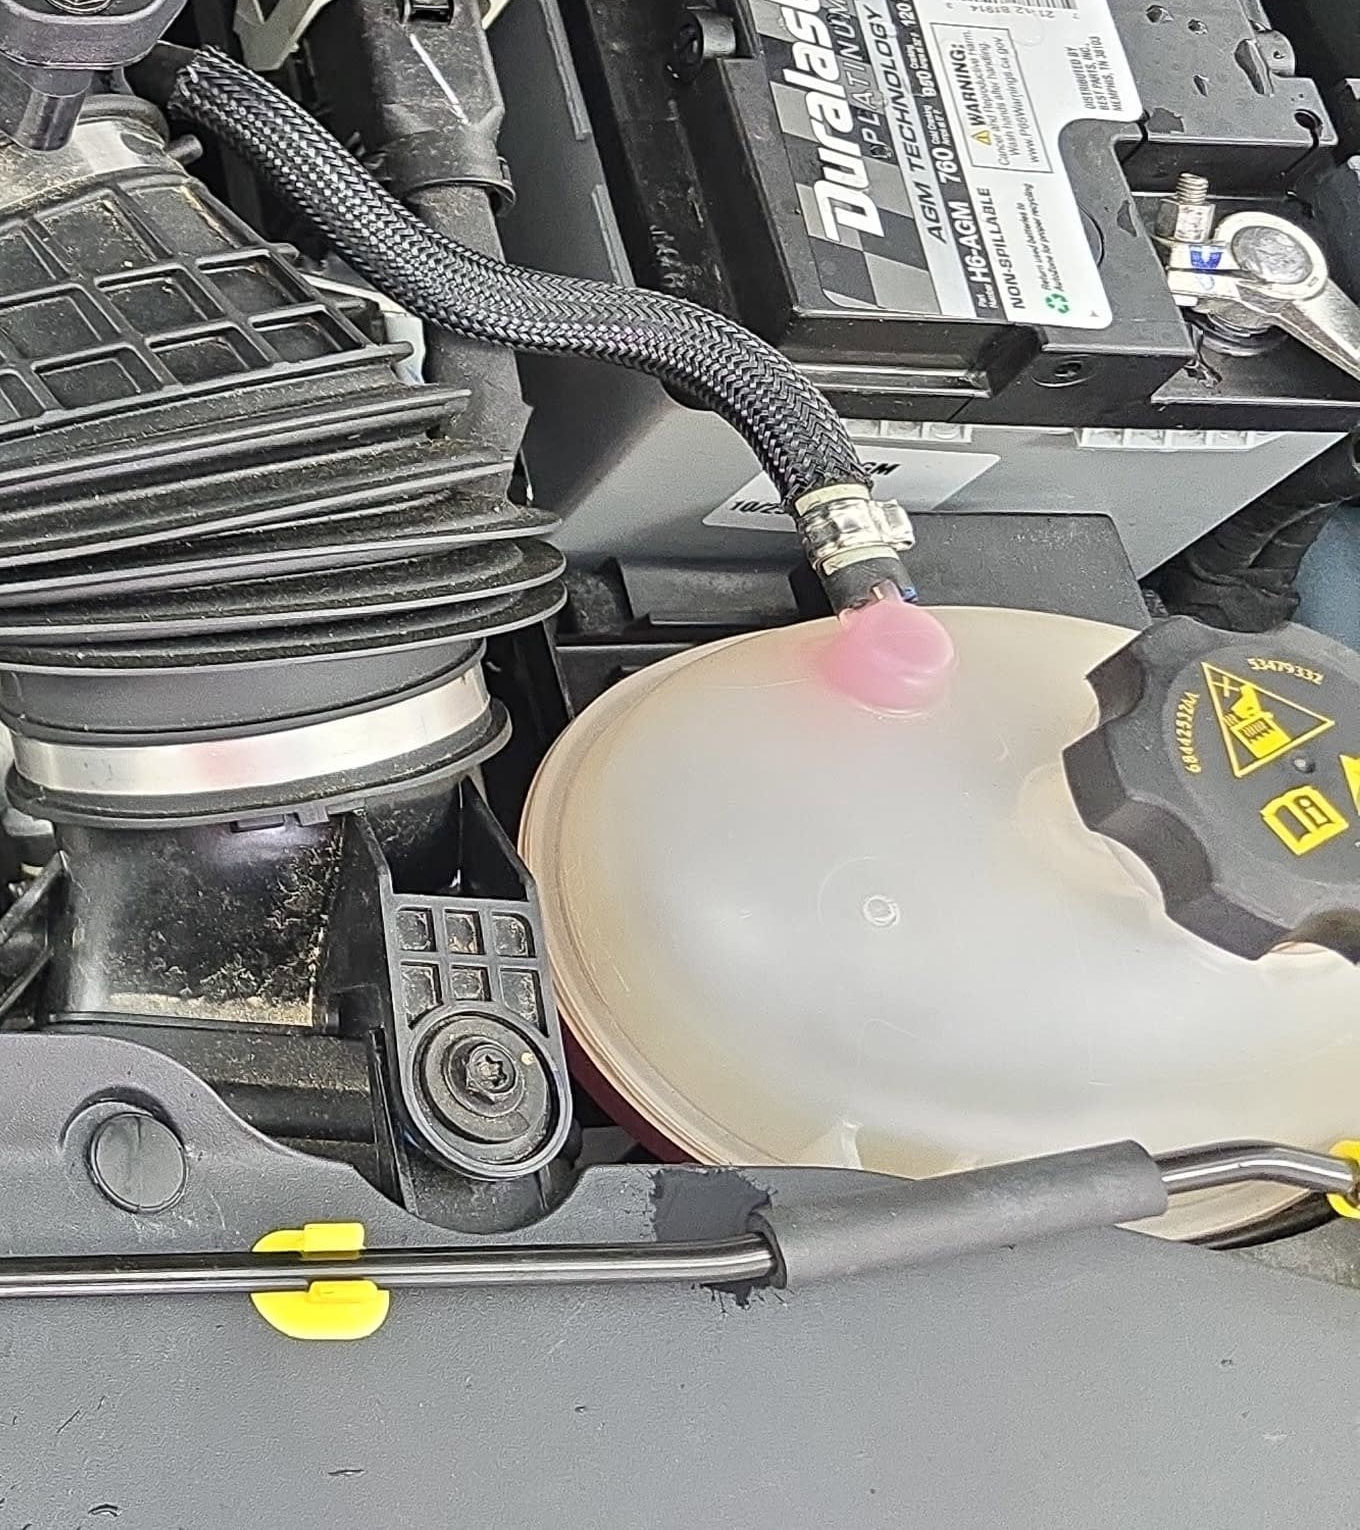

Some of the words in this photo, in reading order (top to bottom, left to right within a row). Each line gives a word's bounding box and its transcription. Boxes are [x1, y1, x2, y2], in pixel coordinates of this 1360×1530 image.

[896, 2, 916, 26] 120
[865, 6, 924, 170] TECHNOLOGY
[950, 44, 985, 126] WARNING:
[996, 102, 1012, 129] hands
[993, 133, 1010, 165] Cancer
[1005, 131, 1020, 156] Wash
[932, 147, 961, 182] 760
[914, 181, 945, 242] AGM
[950, 201, 990, 282] H6-AGM
[977, 188, 1024, 309] NON-SPILLABLE
[1037, 264, 1051, 290] Return
